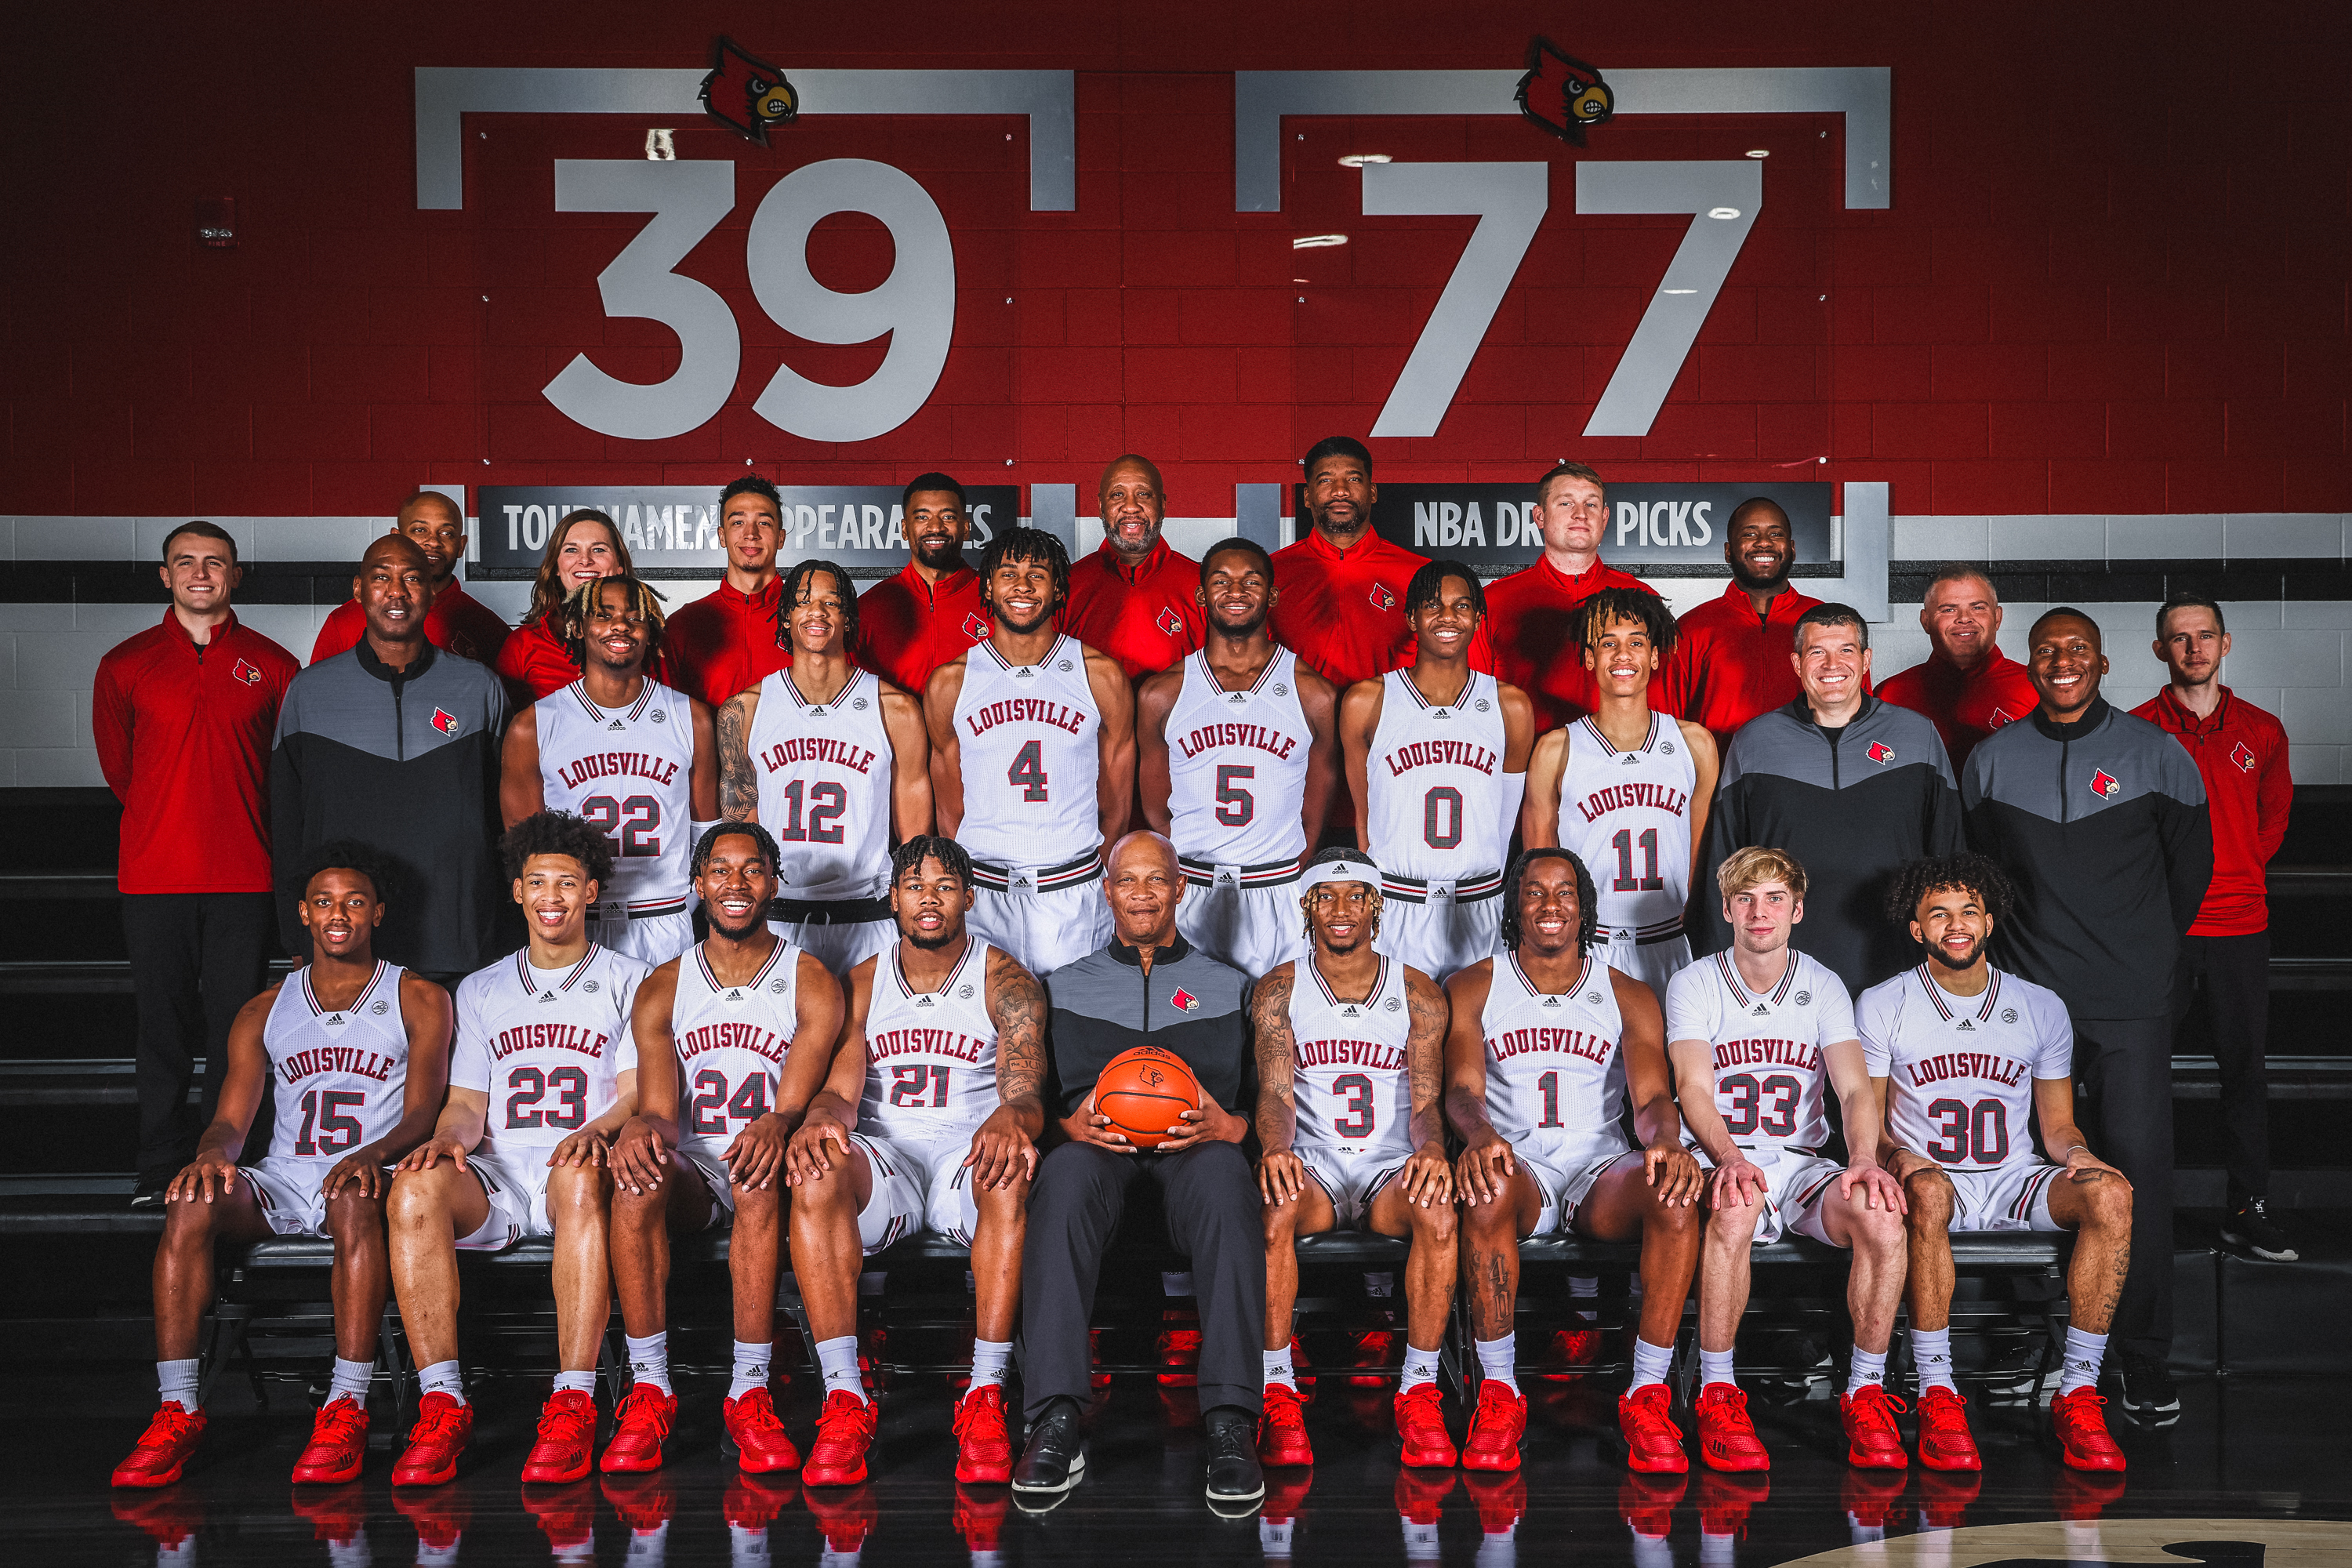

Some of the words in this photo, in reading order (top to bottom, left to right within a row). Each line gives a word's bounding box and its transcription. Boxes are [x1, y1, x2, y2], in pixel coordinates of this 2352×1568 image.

[541, 158, 956, 443] 39
[1363, 160, 1762, 437] 77
[1414, 501, 1486, 546] NBA
[1617, 501, 1712, 546] PICKS
[967, 698, 1087, 737] LOUISVILLE
[760, 738, 877, 775] LOUISVILLE
[1178, 723, 1297, 761] LOUISVILLE
[1385, 740, 1497, 778] LOUISVILLE
[557, 752, 680, 789] LOUISVILLE
[1007, 740, 1048, 802] 4
[782, 779, 847, 844] 12
[1215, 765, 1255, 827] 5
[1424, 786, 1463, 850] 0
[1577, 782, 1687, 823] LOUISVILLE
[582, 795, 661, 857] 22
[1612, 828, 1664, 891] 11
[489, 1023, 609, 1061] LOUISVILLE
[677, 1022, 790, 1065] LOUISVILLE
[866, 1029, 985, 1064] LOUISVILLE
[1133, 1049, 1171, 1060] adidas
[1294, 1039, 1406, 1070] LOUISVILLE
[1490, 1027, 1612, 1066] LOUISVILLE
[278, 1047, 396, 1086] LOUISVILLE
[891, 1065, 952, 1108] 21
[1907, 1052, 2027, 1088] LOUISVILLE
[506, 1066, 589, 1131] 23
[691, 1069, 771, 1135] 24
[1011, 1085, 1027, 1094] TICKET
[1332, 1073, 1375, 1139] 3
[1537, 1071, 1565, 1129] 1
[1719, 1073, 1802, 1137] 33
[295, 1090, 365, 1157] 15
[1927, 1098, 2009, 1164] 30
